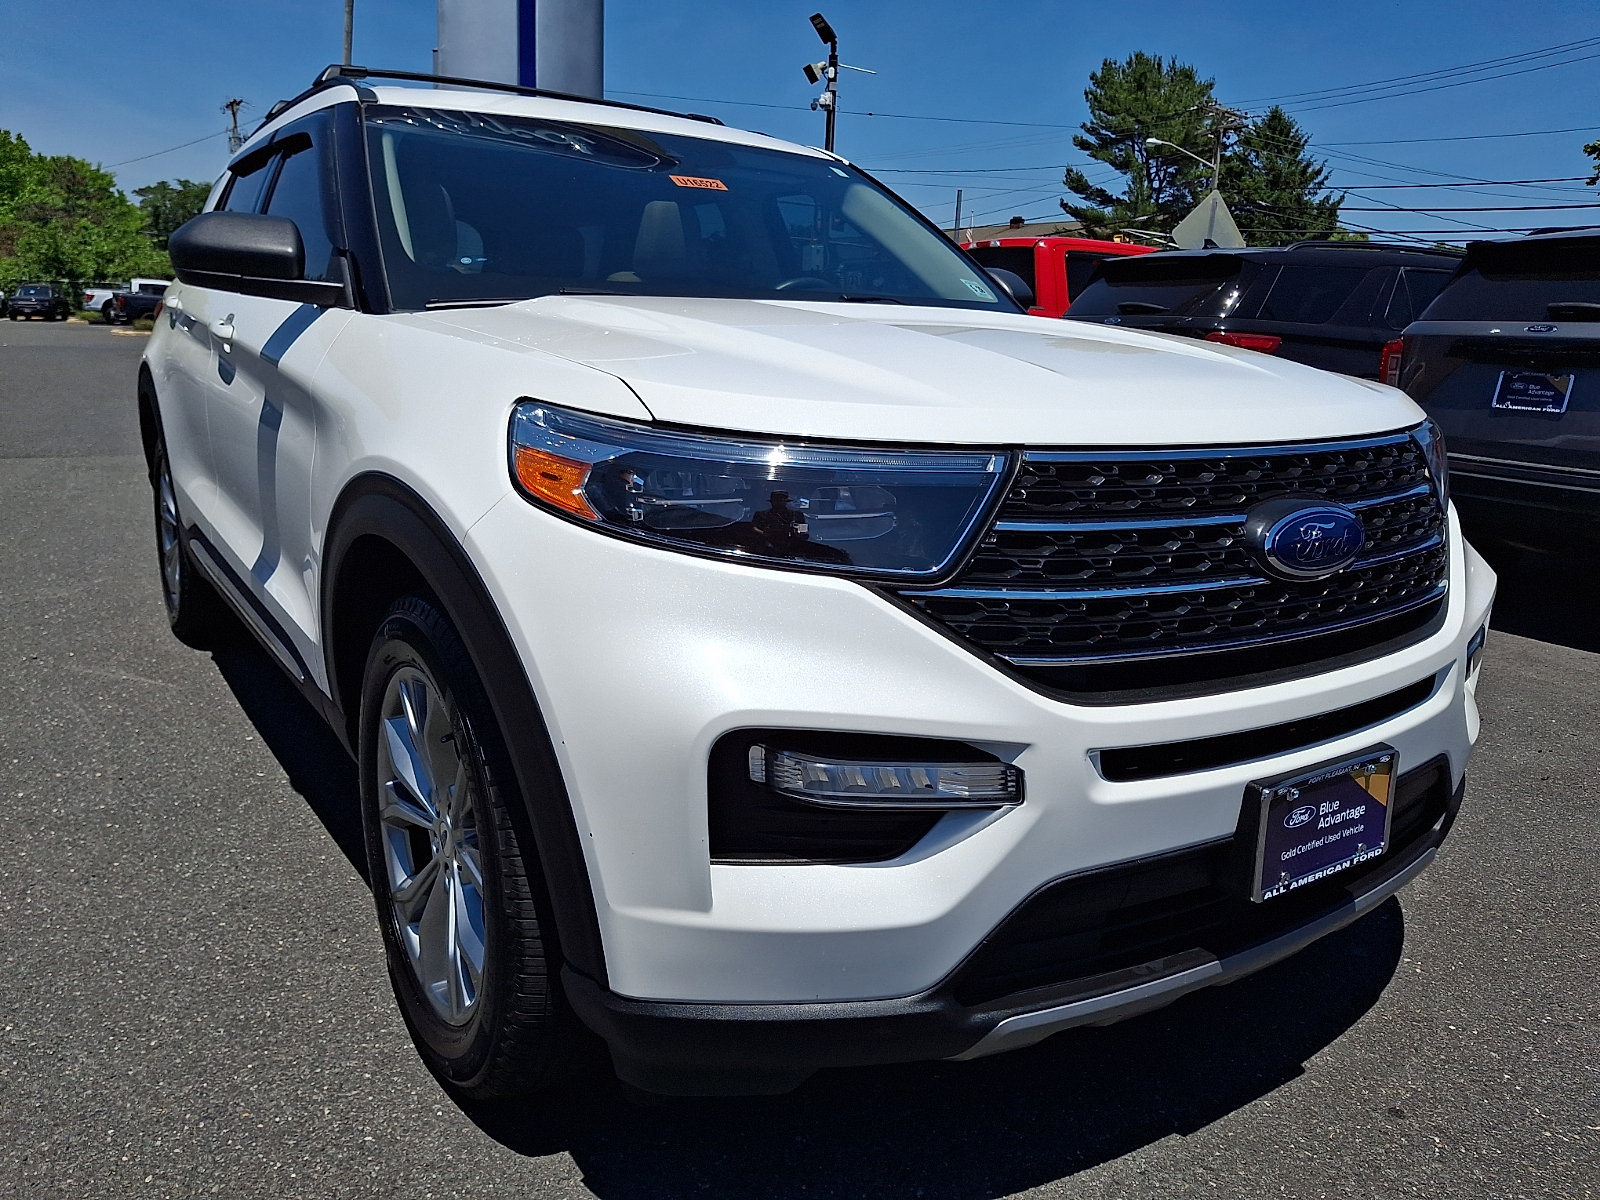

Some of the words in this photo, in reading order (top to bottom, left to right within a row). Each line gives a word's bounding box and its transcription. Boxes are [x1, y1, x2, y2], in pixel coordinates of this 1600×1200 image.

[676, 177, 723, 189] U16522
[1297, 521, 1348, 562] Ford
[1289, 808, 1311, 826] Ford
[1317, 804, 1366, 830] Advantage
[1319, 800, 1340, 815] Blue
[1281, 848, 1296, 861] Gold
[1297, 839, 1324, 855] Certified
[1325, 831, 1341, 844] Used
[1342, 824, 1364, 838] Vehicle
[1264, 885, 1287, 900] ALL
[1290, 862, 1351, 890] AMERICAN
[1353, 848, 1382, 865] FORD
